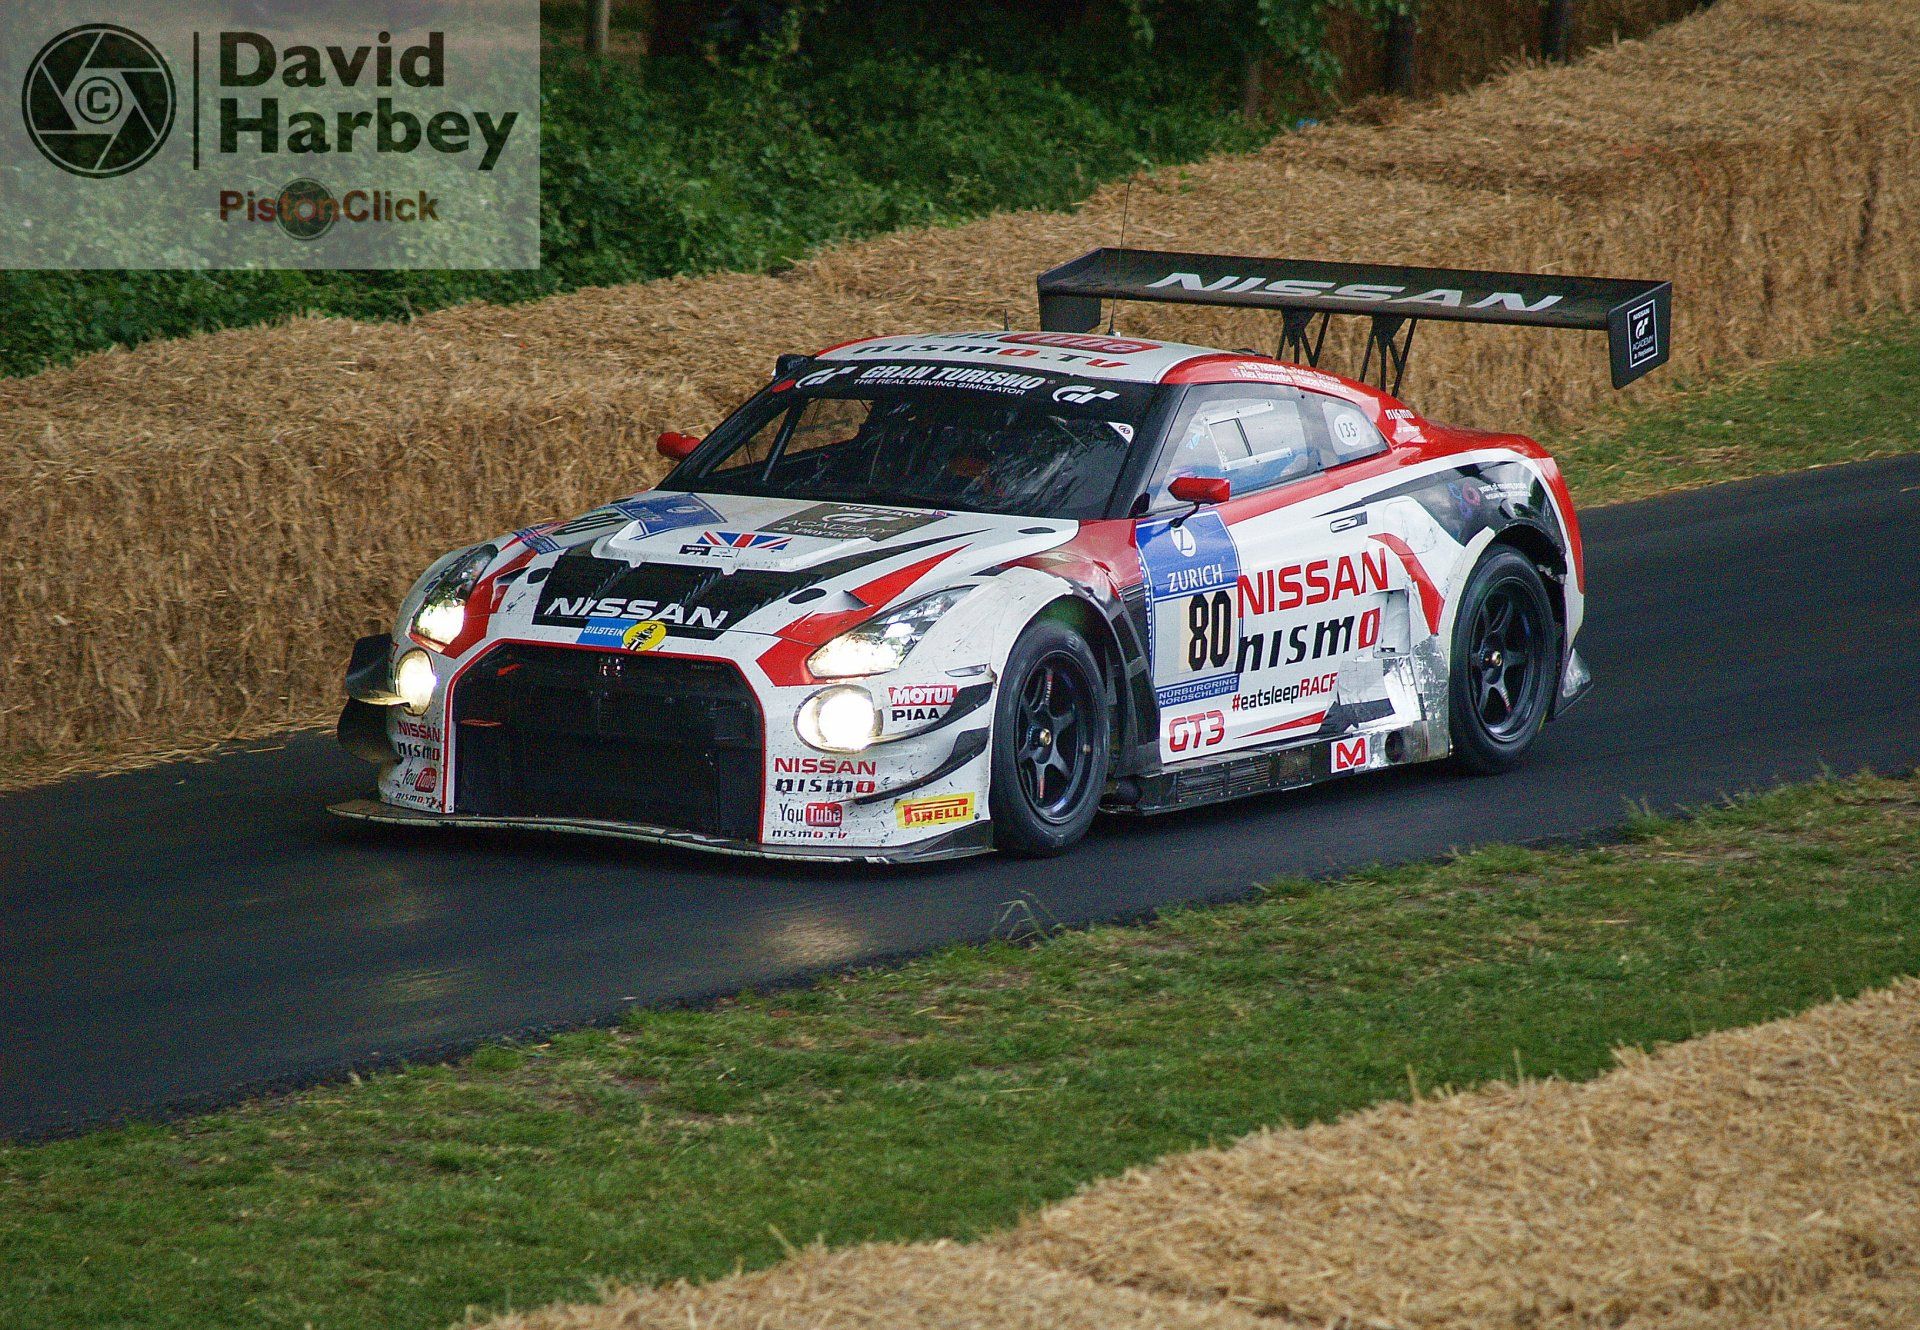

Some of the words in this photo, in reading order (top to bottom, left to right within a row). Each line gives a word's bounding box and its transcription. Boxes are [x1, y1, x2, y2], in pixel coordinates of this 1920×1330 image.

[1147, 273, 1563, 311] NISSAN
[860, 366, 936, 379] GRAN
[932, 367, 1047, 391] TURISMO
[907, 379, 956, 388] DRIVING
[956, 382, 1026, 396] SIMULATOR
[838, 505, 922, 518] NISSAN
[780, 520, 896, 532] ACADEMY
[1167, 564, 1223, 593] ZURICH
[1237, 548, 1389, 618] NISSAN
[543, 597, 729, 629] NISSAN
[584, 626, 625, 636] BILSTEIN
[1188, 590, 1232, 671] 80
[1235, 607, 1381, 674] nismo
[891, 686, 955, 705] MOTUL
[1158, 685, 1237, 706] NORDSCHLEIFE
[1159, 677, 1238, 699] NÜRBURGRING
[892, 708, 940, 722] PIAA
[397, 720, 440, 743] NISSAN
[1169, 709, 1225, 752] GT3
[397, 742, 440, 761] nismo
[774, 757, 876, 775] NISSAN
[775, 777, 876, 793] nismo
[903, 798, 968, 825] PIRELLI
